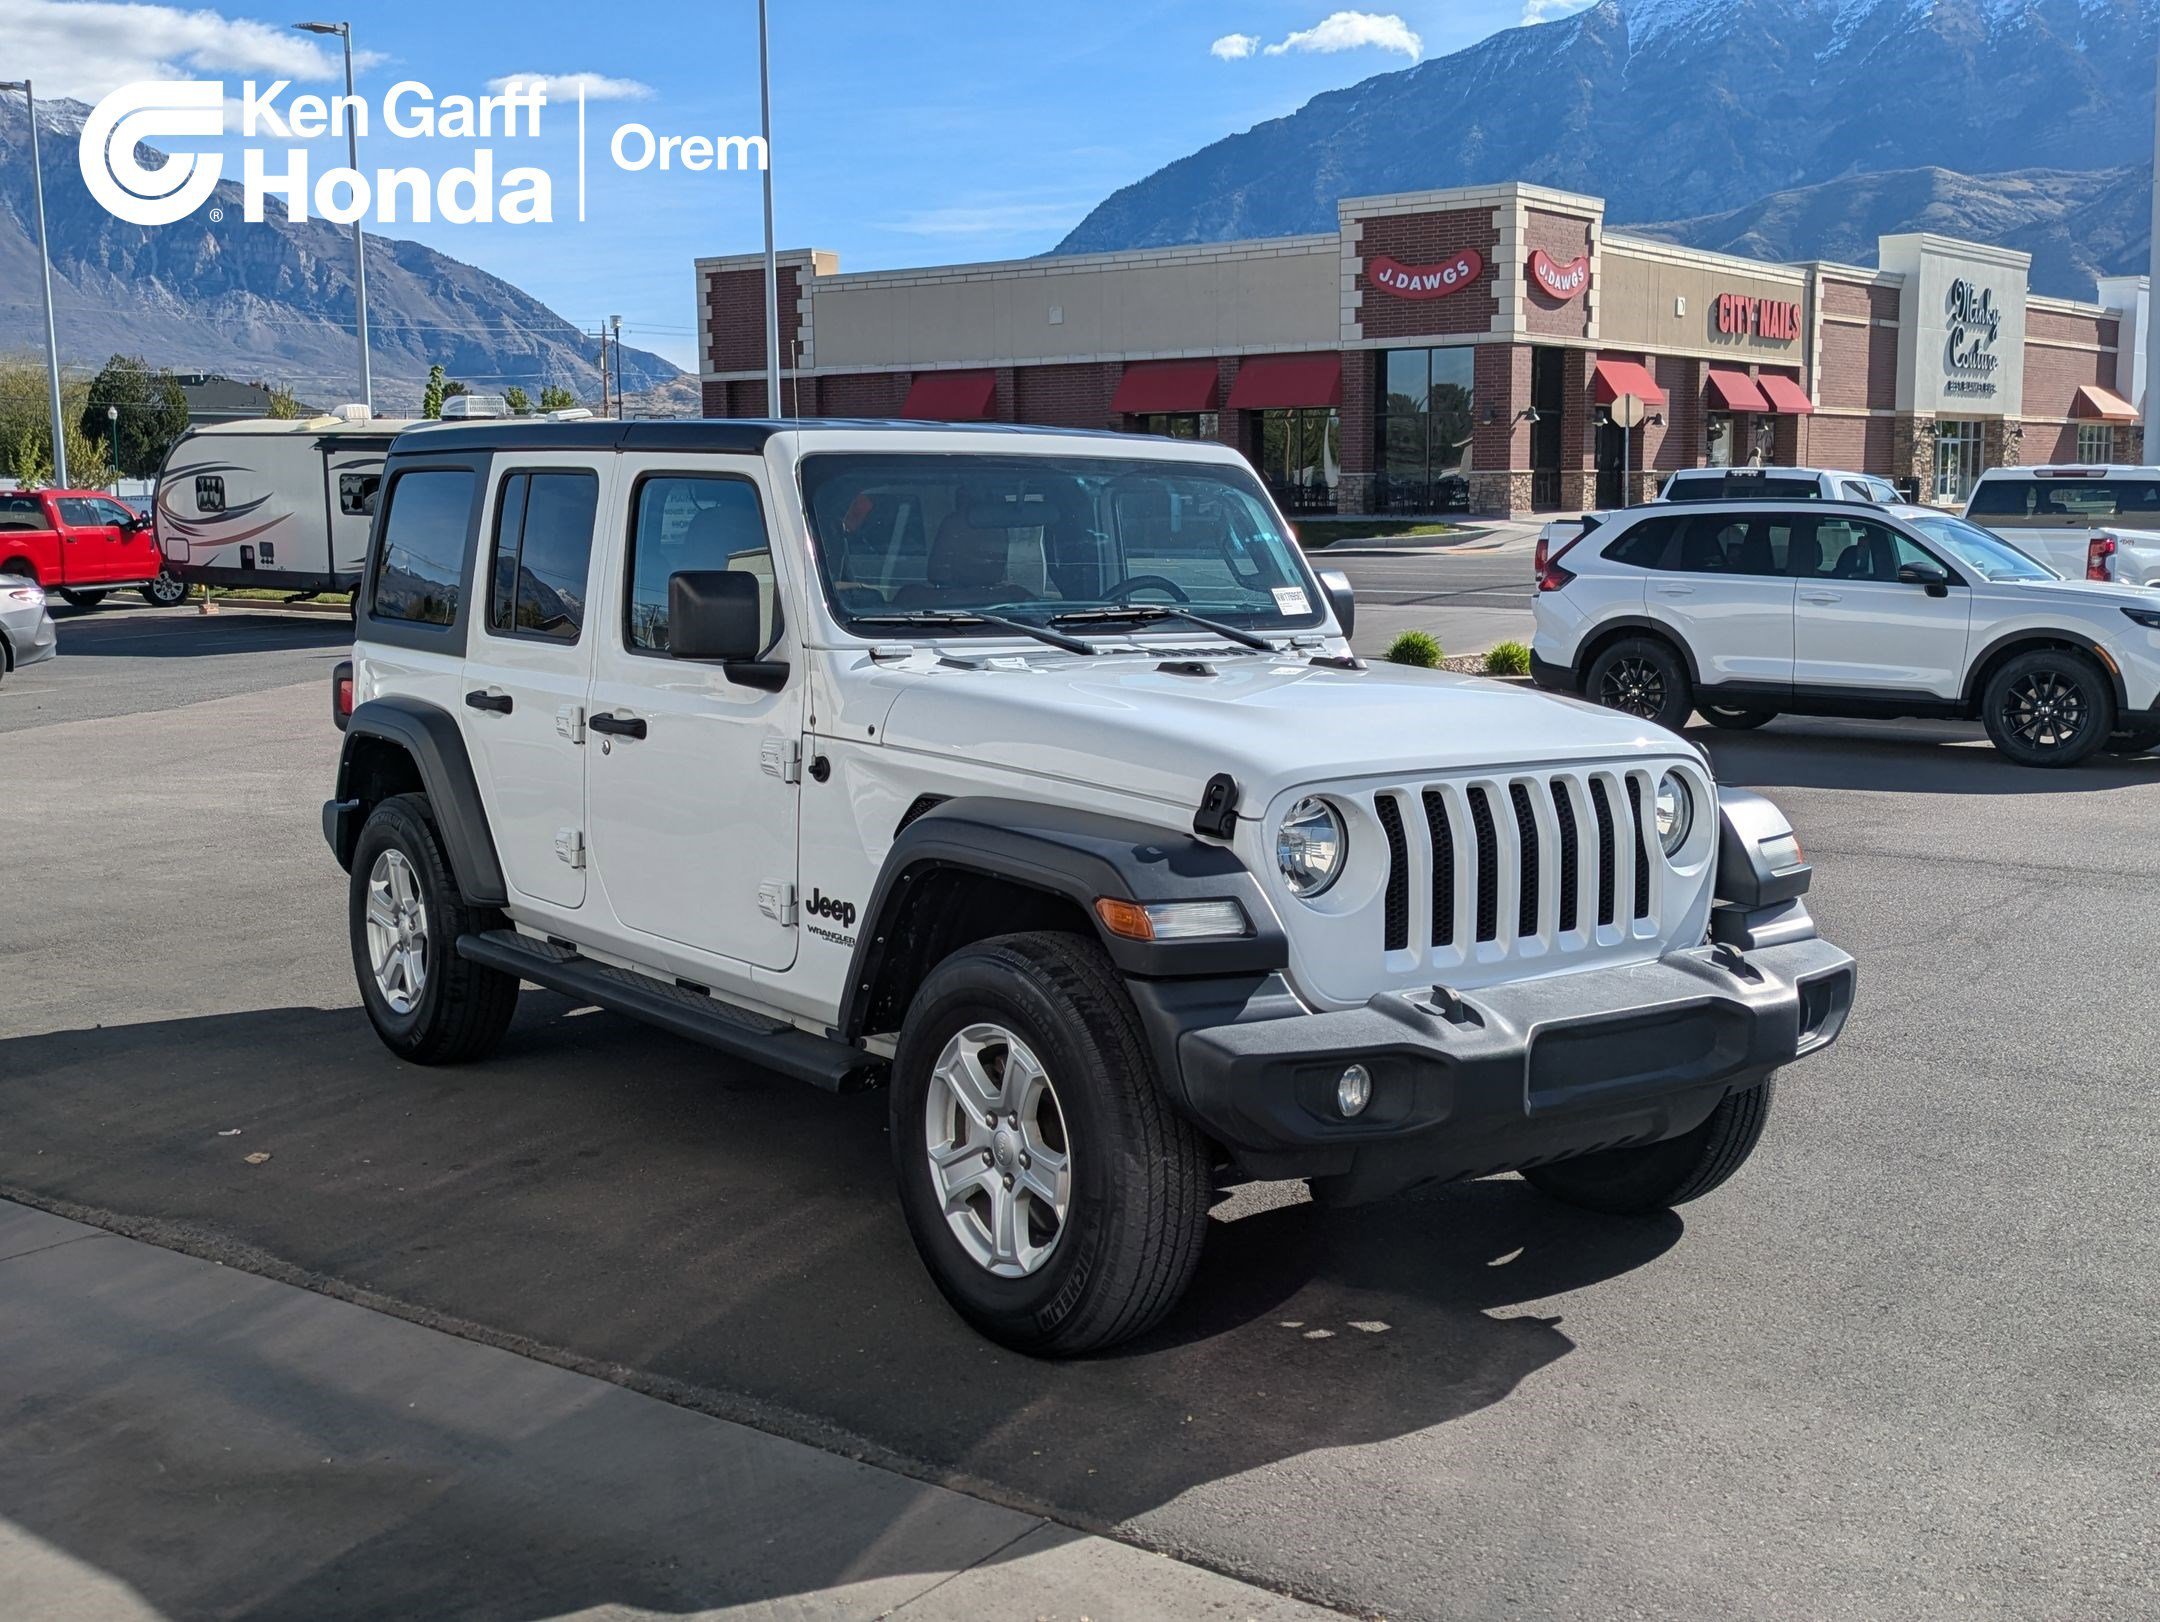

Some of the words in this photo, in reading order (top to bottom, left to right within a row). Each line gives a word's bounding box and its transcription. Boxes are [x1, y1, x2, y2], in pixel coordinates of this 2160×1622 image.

[1379, 259, 1470, 291] J.DAWGS
[1538, 262, 1584, 291] J.DAWGS
[1717, 293, 1755, 335] CITY
[1758, 299, 1801, 340] NAILS
[1950, 277, 2001, 342] Minky
[1949, 325, 1999, 371] Couture
[805, 887, 856, 929] Jeep
[807, 924, 856, 945] WRANGLER
